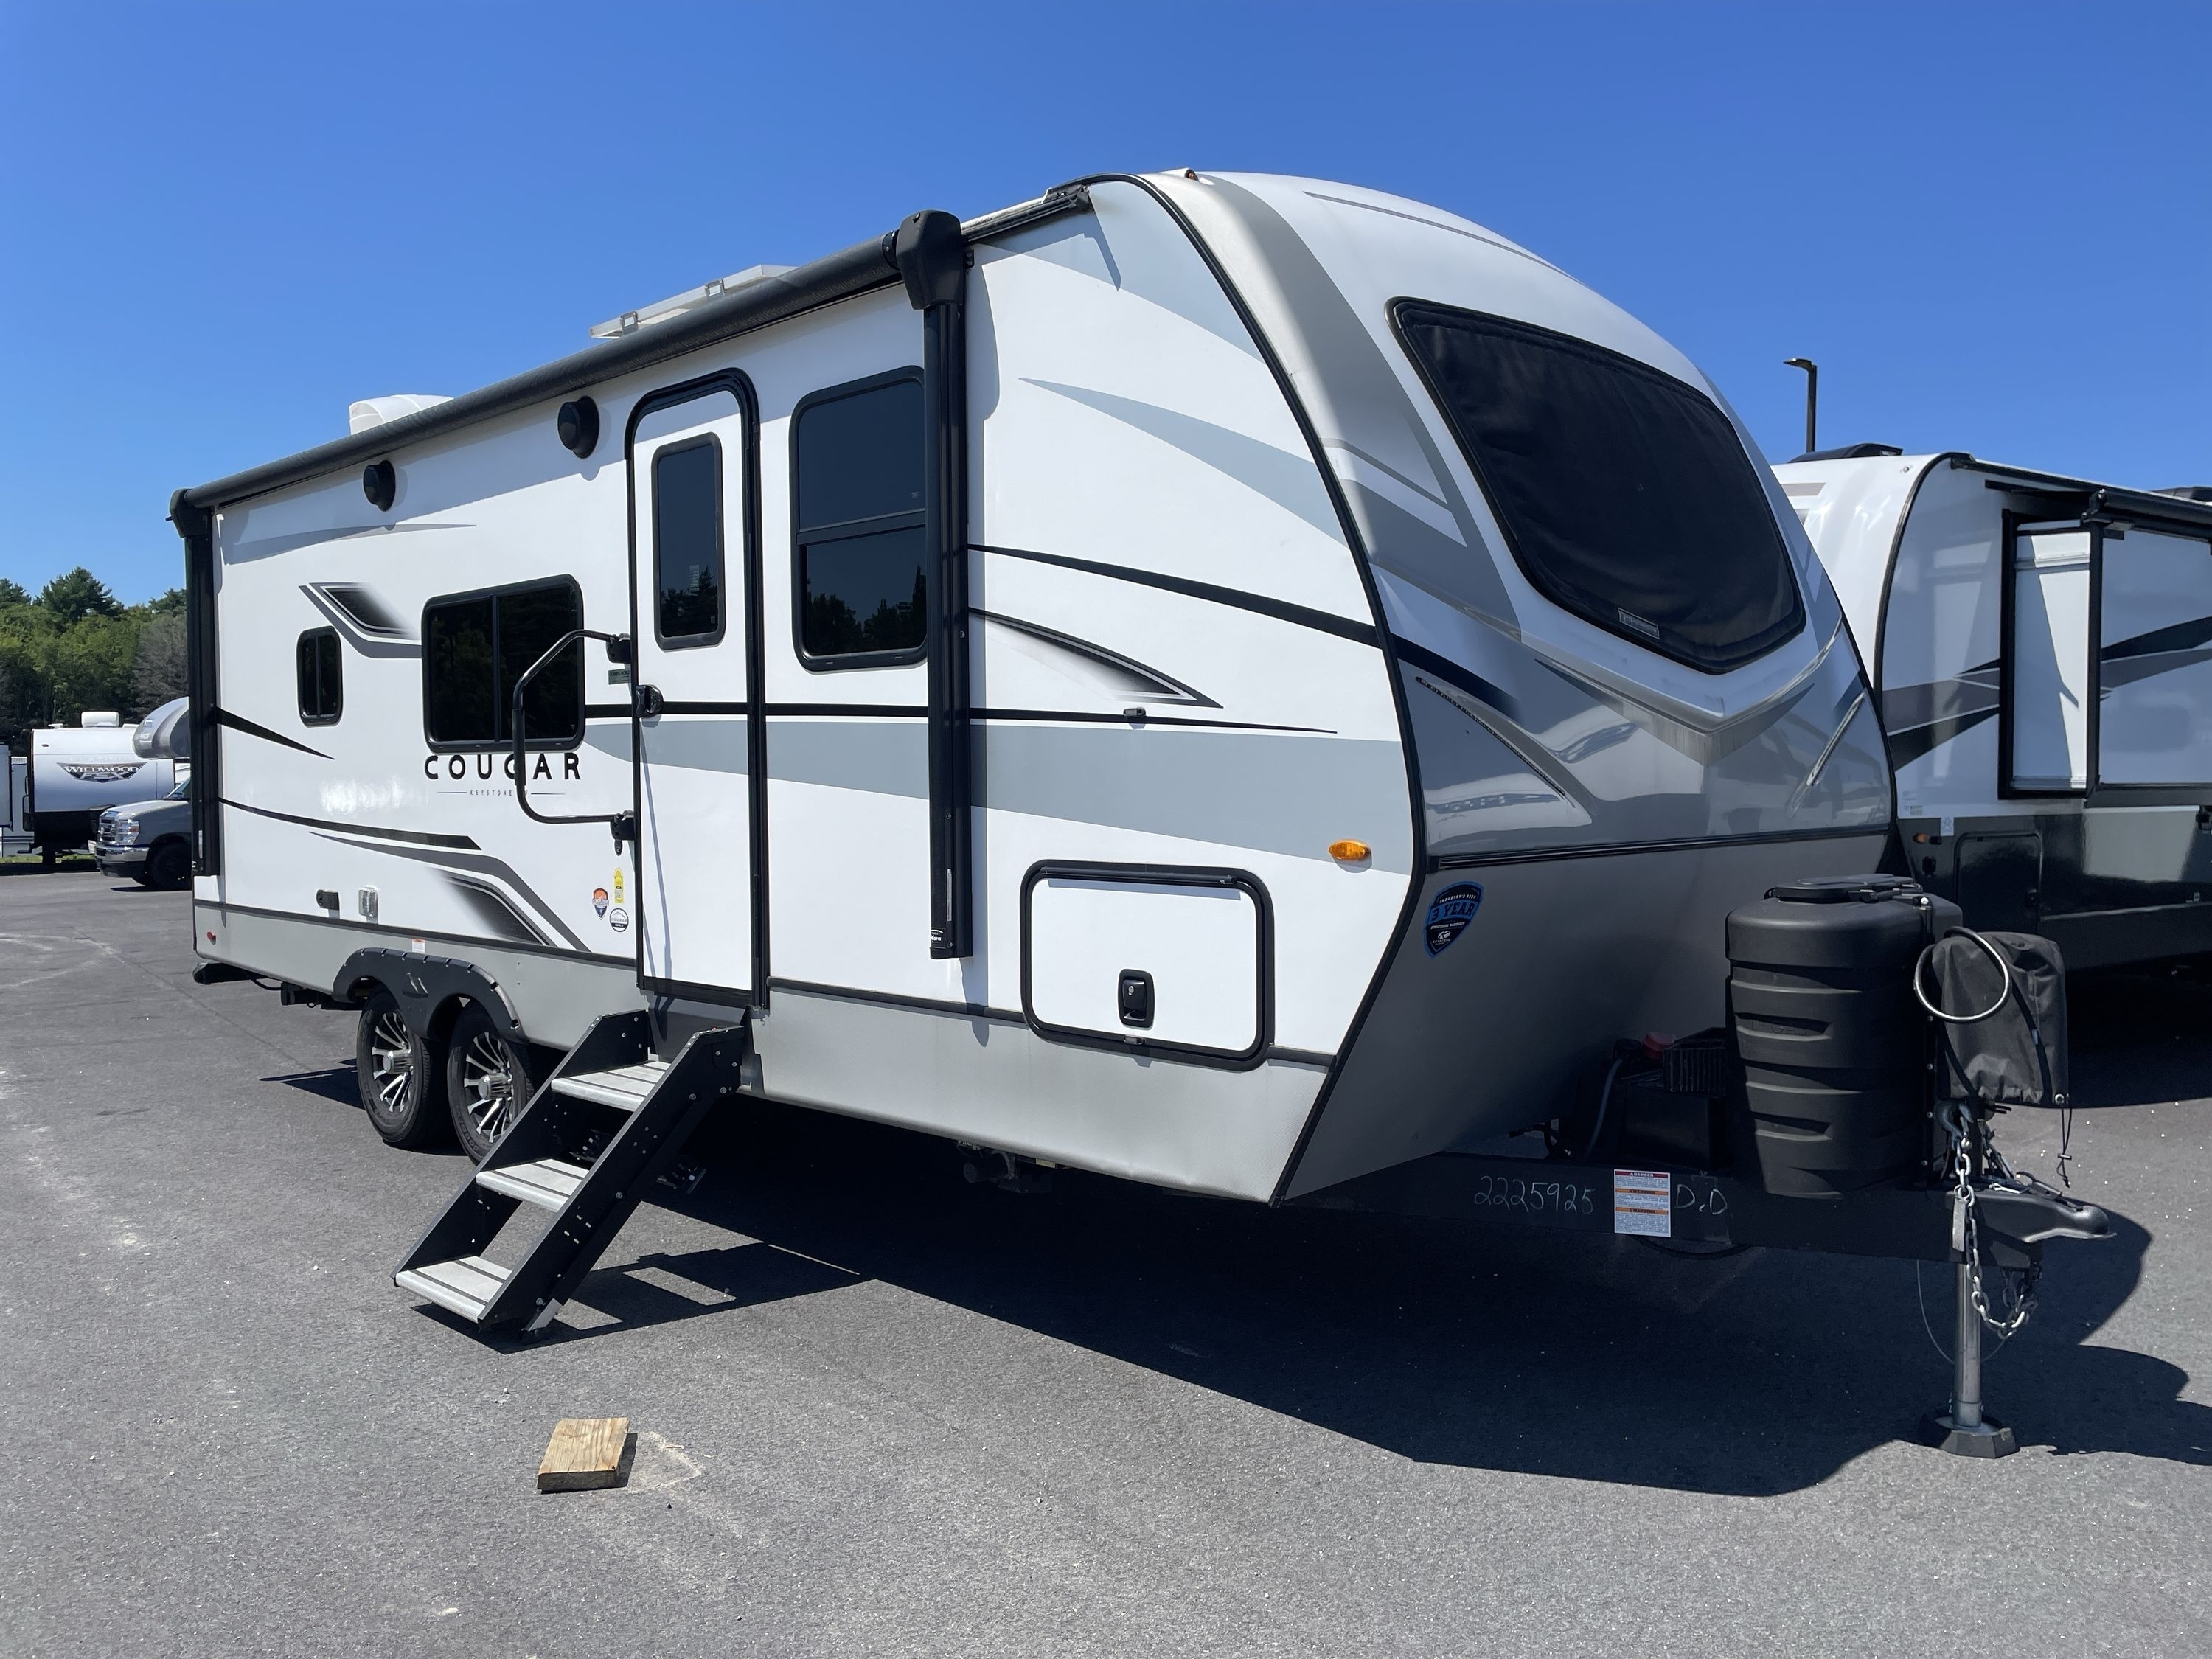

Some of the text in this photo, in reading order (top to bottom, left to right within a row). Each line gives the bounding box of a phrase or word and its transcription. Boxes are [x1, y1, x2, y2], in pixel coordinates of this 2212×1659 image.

[1432, 902, 1475, 921] 3 YEAR
[1475, 1176, 1596, 1214] 2225925
